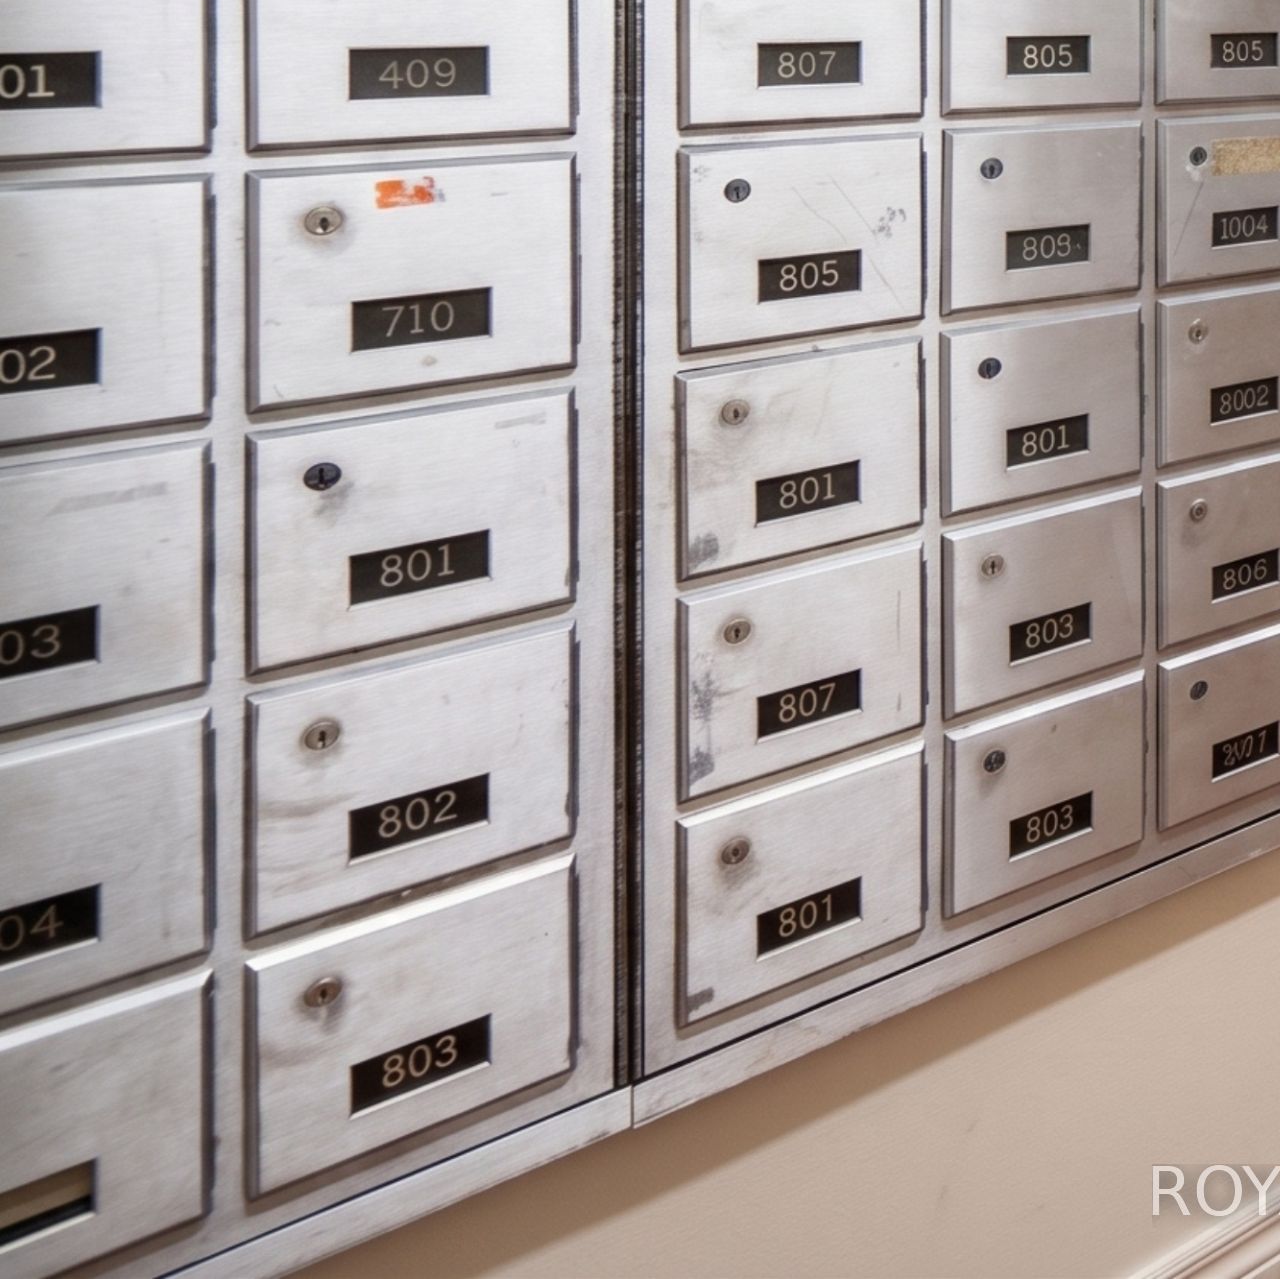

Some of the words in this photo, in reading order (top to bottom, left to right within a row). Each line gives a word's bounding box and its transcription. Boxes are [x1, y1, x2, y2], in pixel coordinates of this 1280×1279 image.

[778, 50, 836, 80] 807
[1023, 43, 1073, 70] 805
[1222, 39, 1264, 64] 805
[378, 57, 456, 90] 409
[1219, 214, 1269, 242] 1004
[779, 260, 839, 293] 805
[382, 300, 454, 337] 710
[1218, 385, 1269, 416] 8002
[1022, 424, 1069, 456] 801
[779, 472, 835, 510] 801
[380, 542, 455, 588] 801
[1222, 558, 1267, 592] 806
[1025, 613, 1074, 650] 803
[778, 682, 835, 722] 807
[378, 790, 457, 839] 802
[1026, 806, 1074, 843] 803
[778, 894, 834, 938] 801
[382, 1035, 457, 1089] 803
